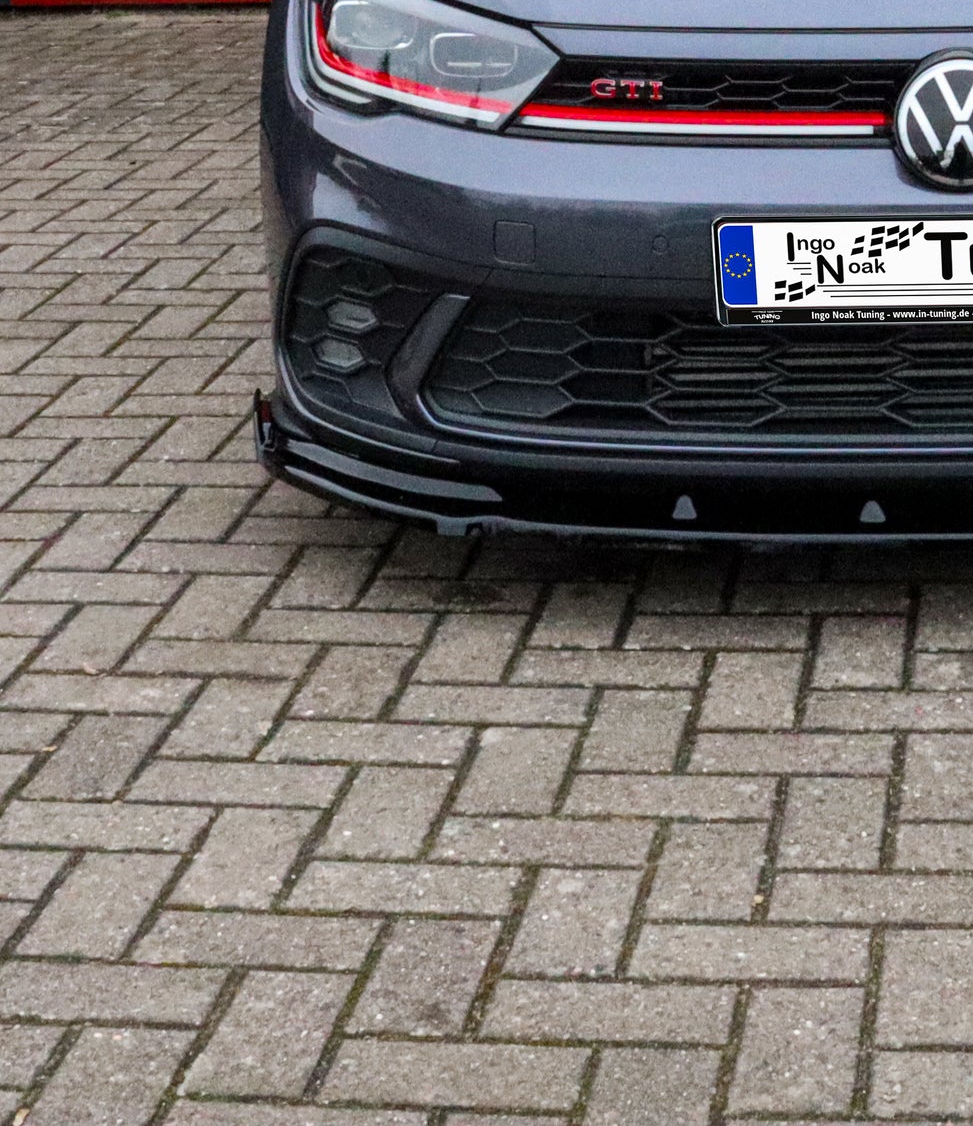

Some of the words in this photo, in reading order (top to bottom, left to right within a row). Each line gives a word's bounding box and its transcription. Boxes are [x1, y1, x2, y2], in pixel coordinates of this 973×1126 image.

[590, 78, 664, 100] GTI
[786, 231, 836, 262] Ingo
[817, 254, 887, 285] Noak
[811, 311, 831, 322] Ingo
[832, 310, 855, 320] Noak
[856, 310, 885, 322] Tuning
[892, 308, 970, 320] www.in-tuning.de
